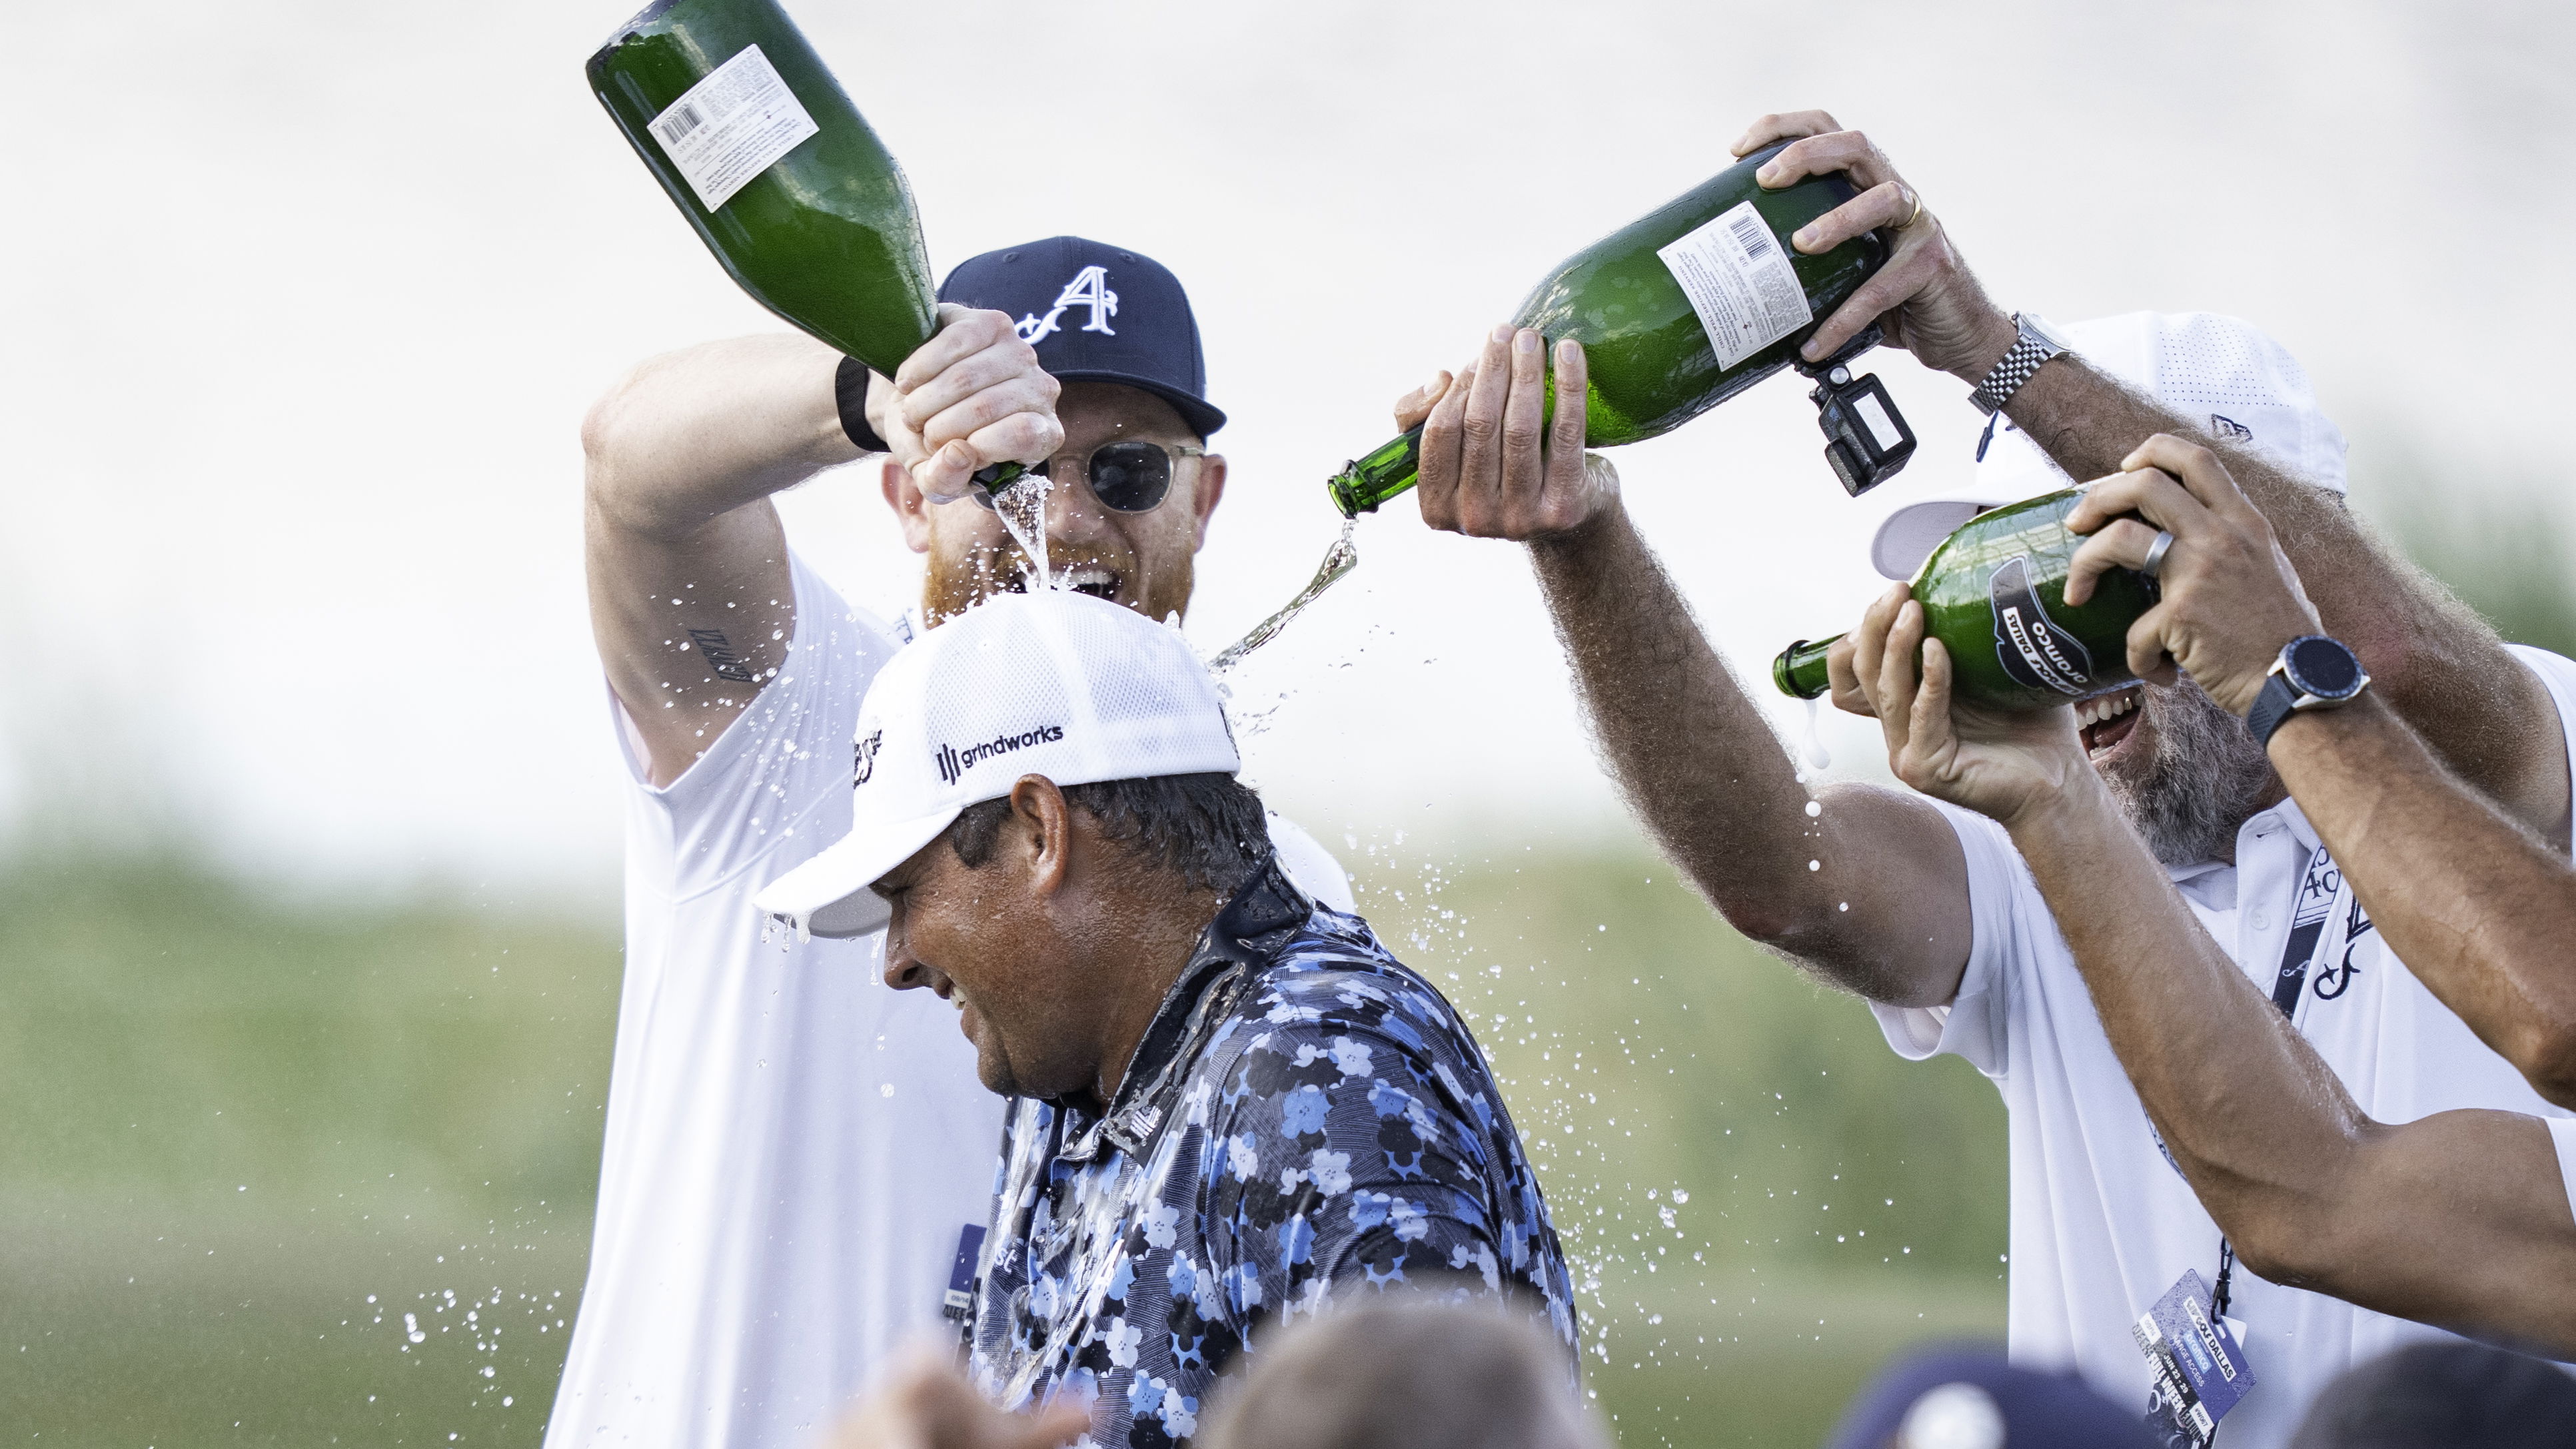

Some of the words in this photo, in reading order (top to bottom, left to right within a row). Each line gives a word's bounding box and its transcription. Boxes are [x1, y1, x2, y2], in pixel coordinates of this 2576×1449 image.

[2008, 614, 2032, 654] DALLAS
[2032, 622, 2088, 683] aramco
[961, 725, 1064, 769] grindworks
[2173, 1334, 2190, 1359] RANGE
[2186, 1359, 2205, 1386] ACCESS
[2186, 1334, 2208, 1370] aramco
[2196, 1317, 2212, 1338] GOLF
[2209, 1339, 2233, 1378] DALLAS
[2148, 1352, 2167, 1384] FULL
[2161, 1375, 2186, 1414] WEEK
[2164, 1354, 2175, 1370] JUN
[2172, 1369, 2181, 1379] 23
[2180, 1382, 2188, 1394] 29
